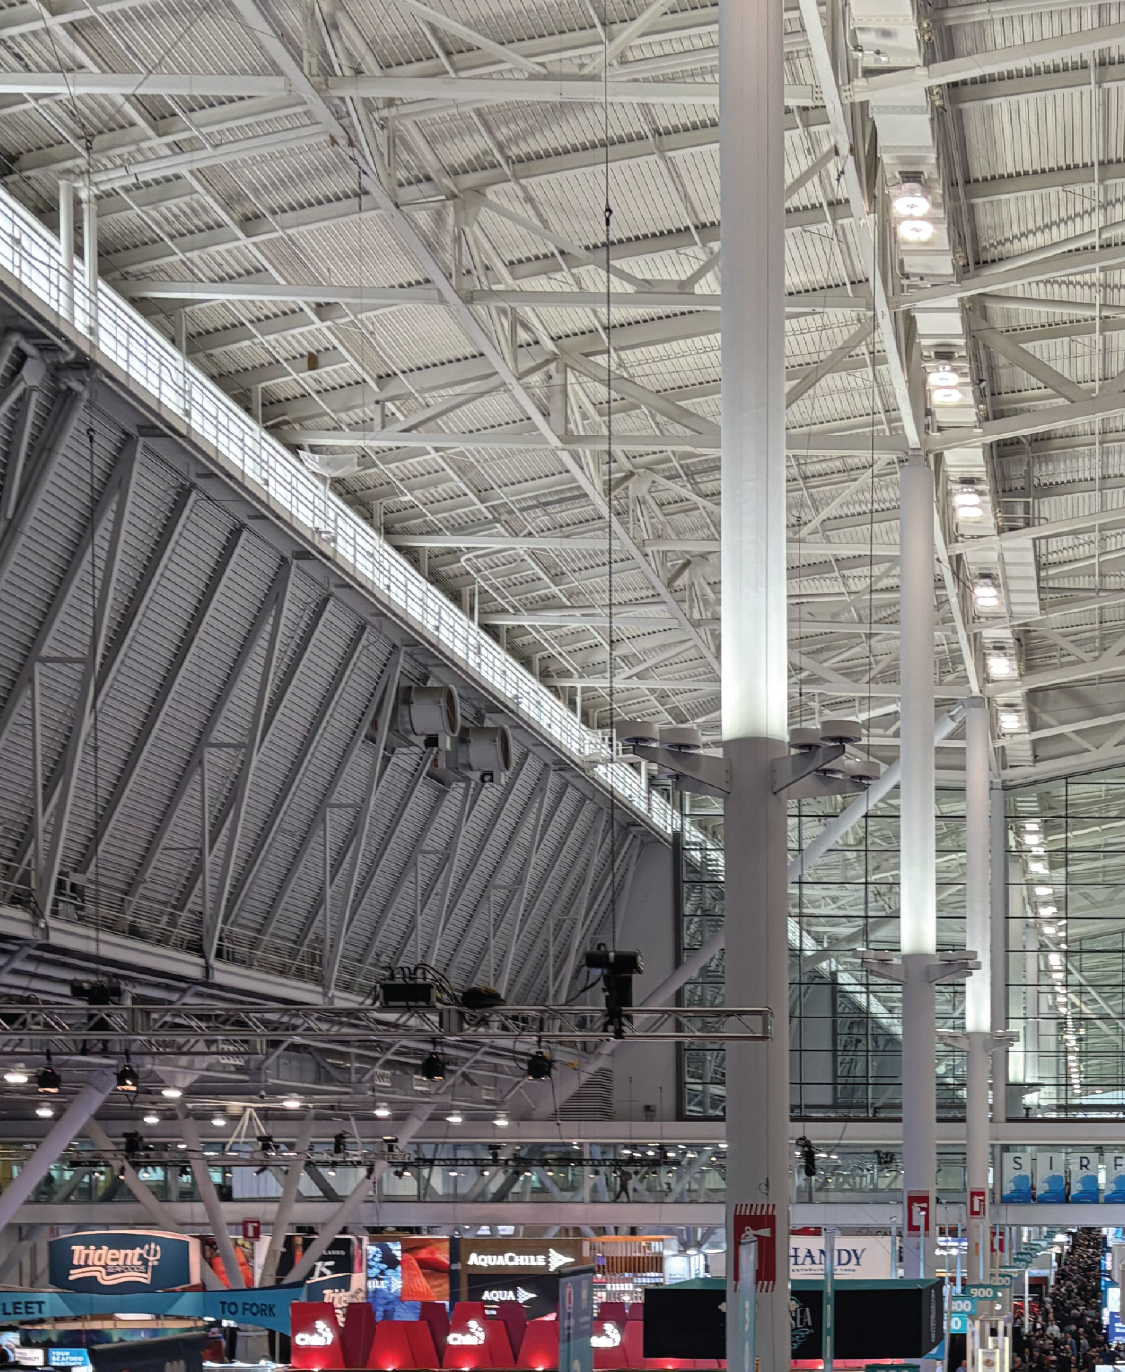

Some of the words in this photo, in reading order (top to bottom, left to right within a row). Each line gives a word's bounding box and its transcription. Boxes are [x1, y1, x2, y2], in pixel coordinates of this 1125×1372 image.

[71, 1245, 143, 1266] Trident
[482, 1290, 516, 1301] AQUA
[970, 1288, 994, 1298] 900
[2, 1300, 46, 1316] LEET
[219, 1301, 239, 1316] TO
[242, 1302, 276, 1318] FORK
